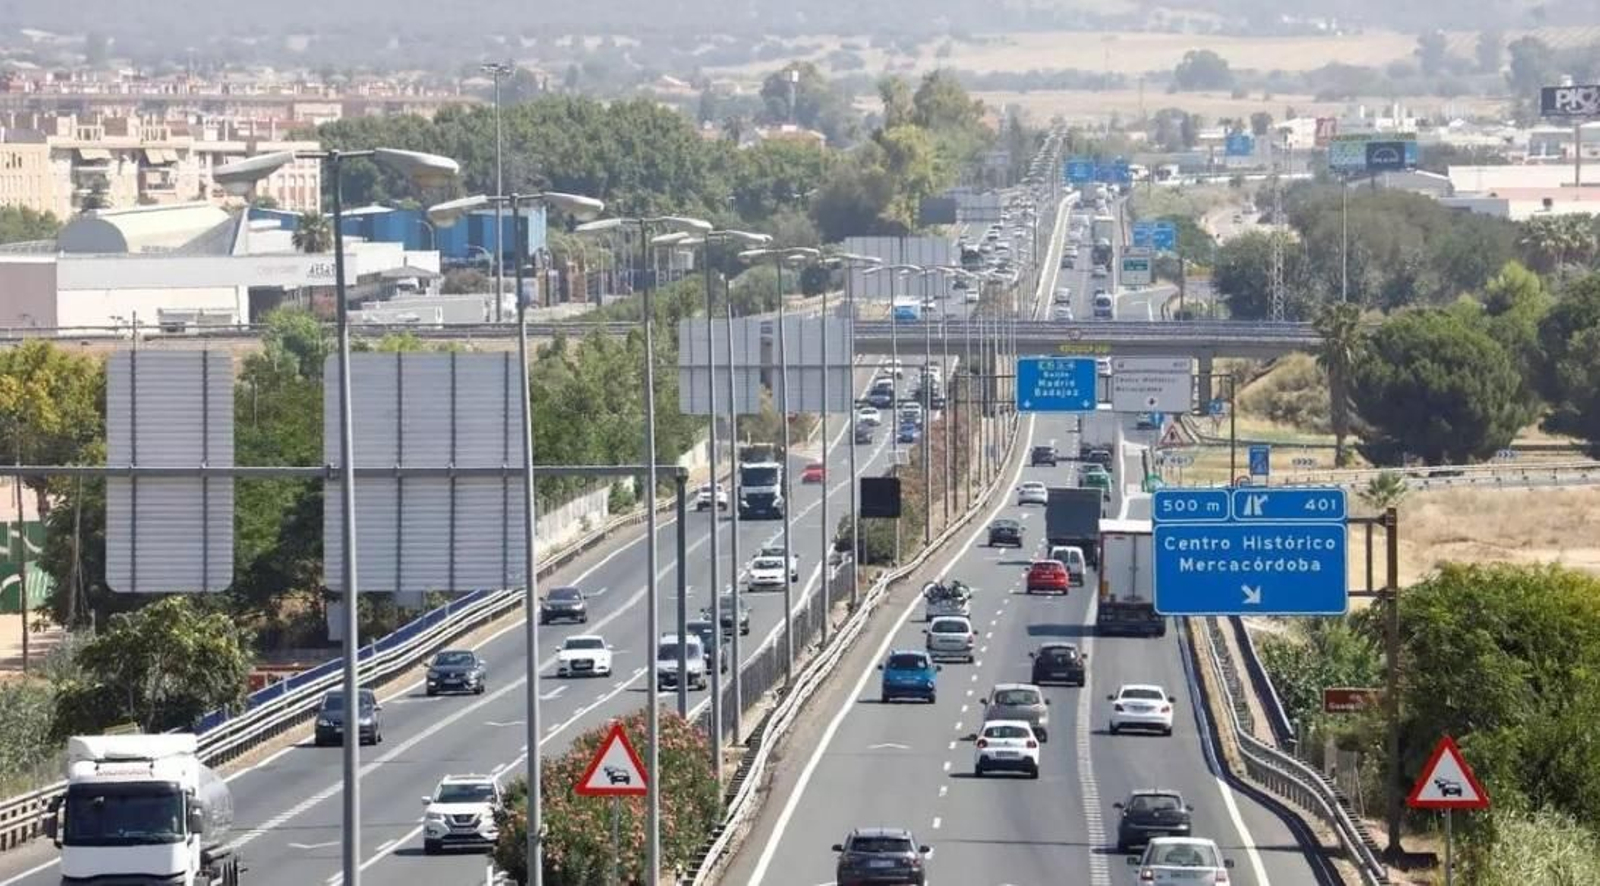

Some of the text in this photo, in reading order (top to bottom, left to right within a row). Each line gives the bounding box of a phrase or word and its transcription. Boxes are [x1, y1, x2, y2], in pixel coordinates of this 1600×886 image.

[1162, 499, 1220, 512] 500 m
[1304, 499, 1336, 511] 401
[1164, 535, 1336, 550] Centro Histórico
[1179, 556, 1321, 572] Mercacórdoba
